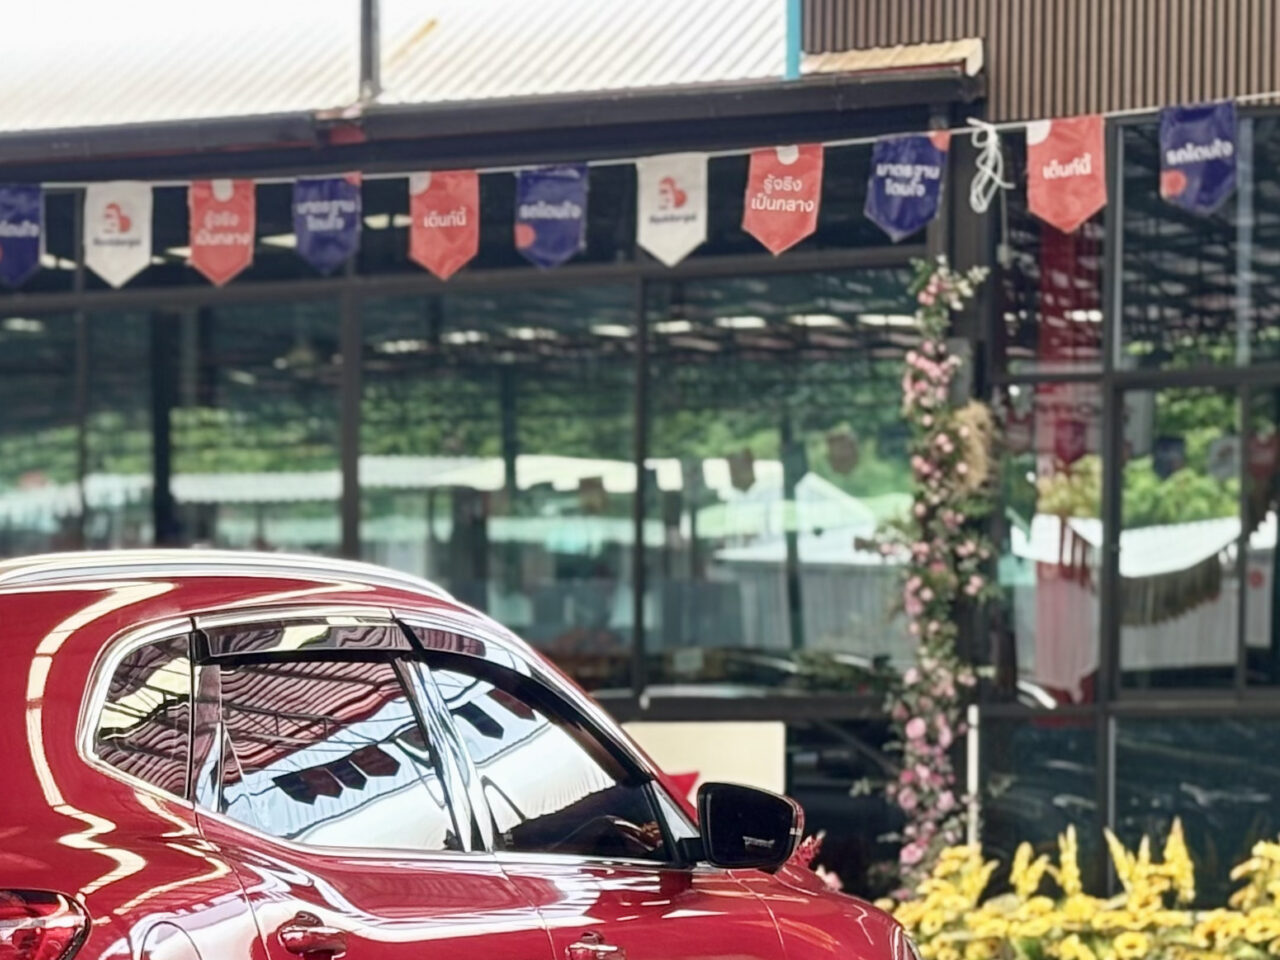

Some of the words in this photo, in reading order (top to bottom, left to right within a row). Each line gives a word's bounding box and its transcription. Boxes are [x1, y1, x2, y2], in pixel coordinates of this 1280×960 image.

[763, 173, 803, 195] รู้จริง
[751, 192, 815, 213] เป็นกลาง
